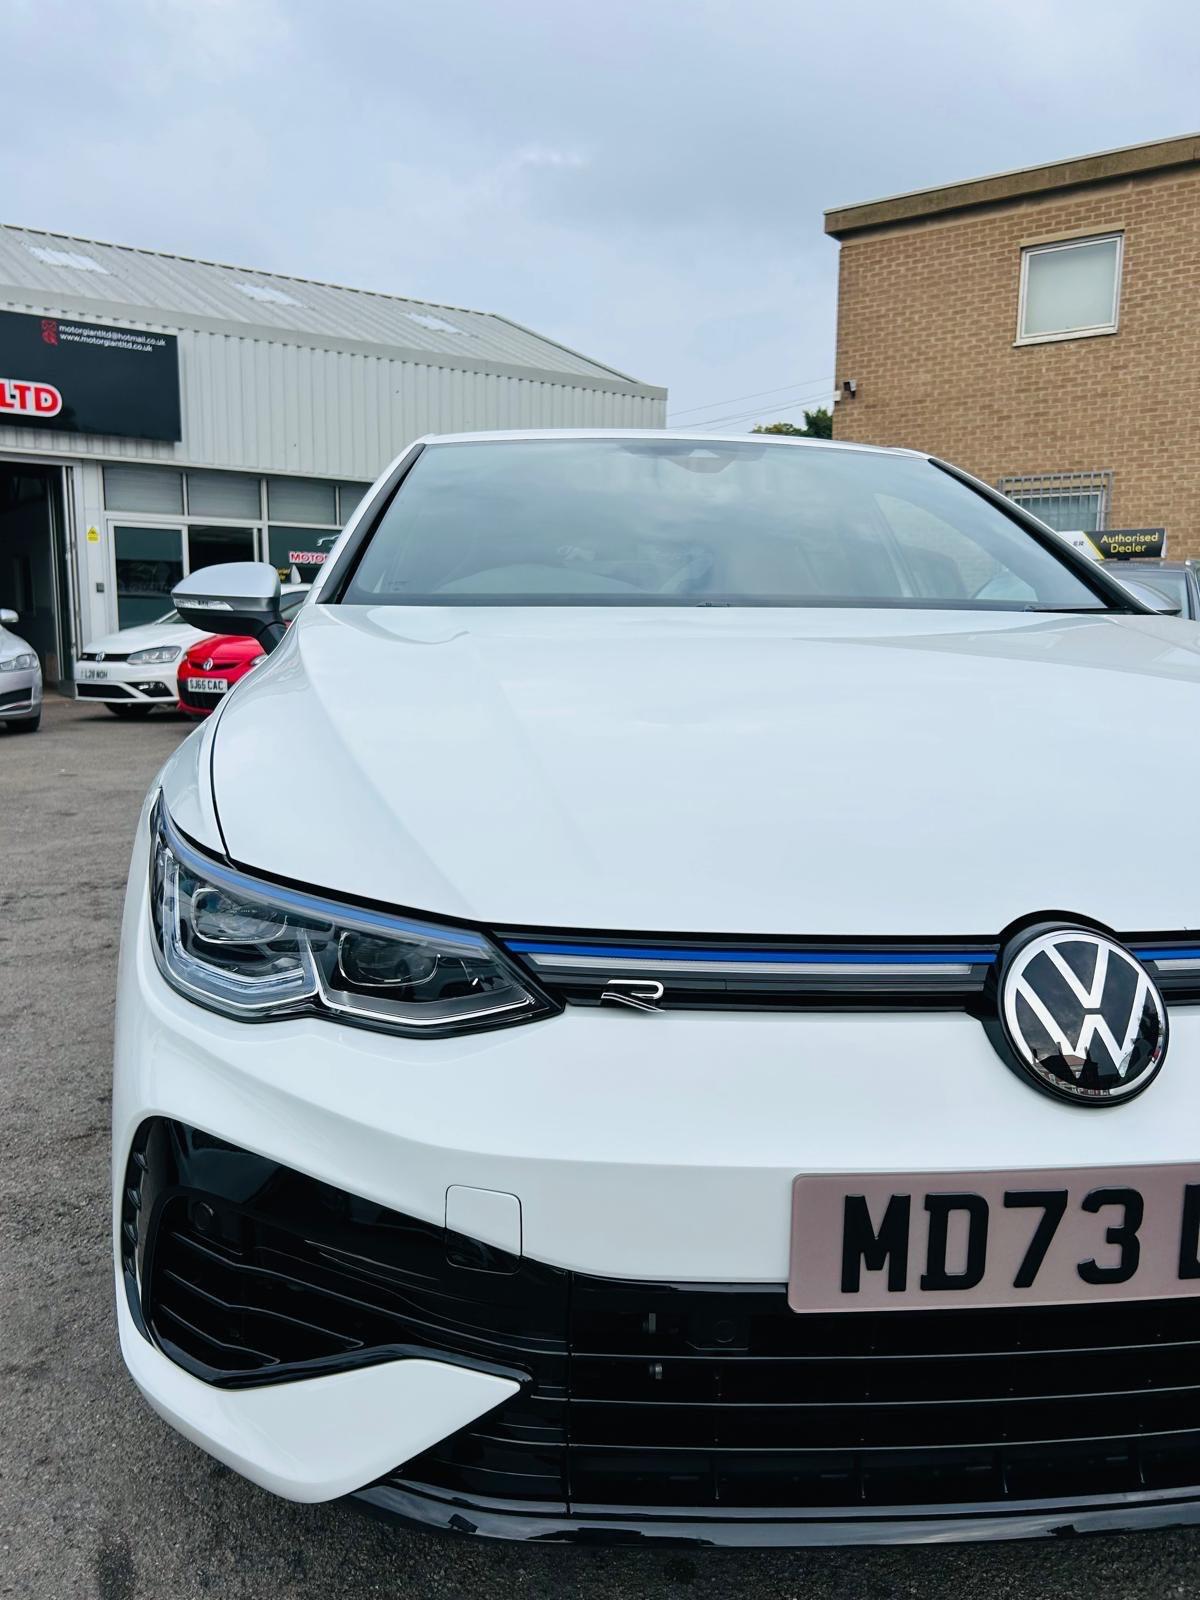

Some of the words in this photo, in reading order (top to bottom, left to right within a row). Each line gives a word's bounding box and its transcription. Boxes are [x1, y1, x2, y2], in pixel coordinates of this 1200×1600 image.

[59, 325, 166, 346] motorgiantltd@hotmail.co.uk
[60, 333, 153, 352] www.motorgiantltd.co.uk
[1100, 531, 1159, 543] Authorised
[1110, 543, 1147, 553] Dealer
[207, 680, 224, 691] CAC
[841, 1185, 1144, 1293] MD73
